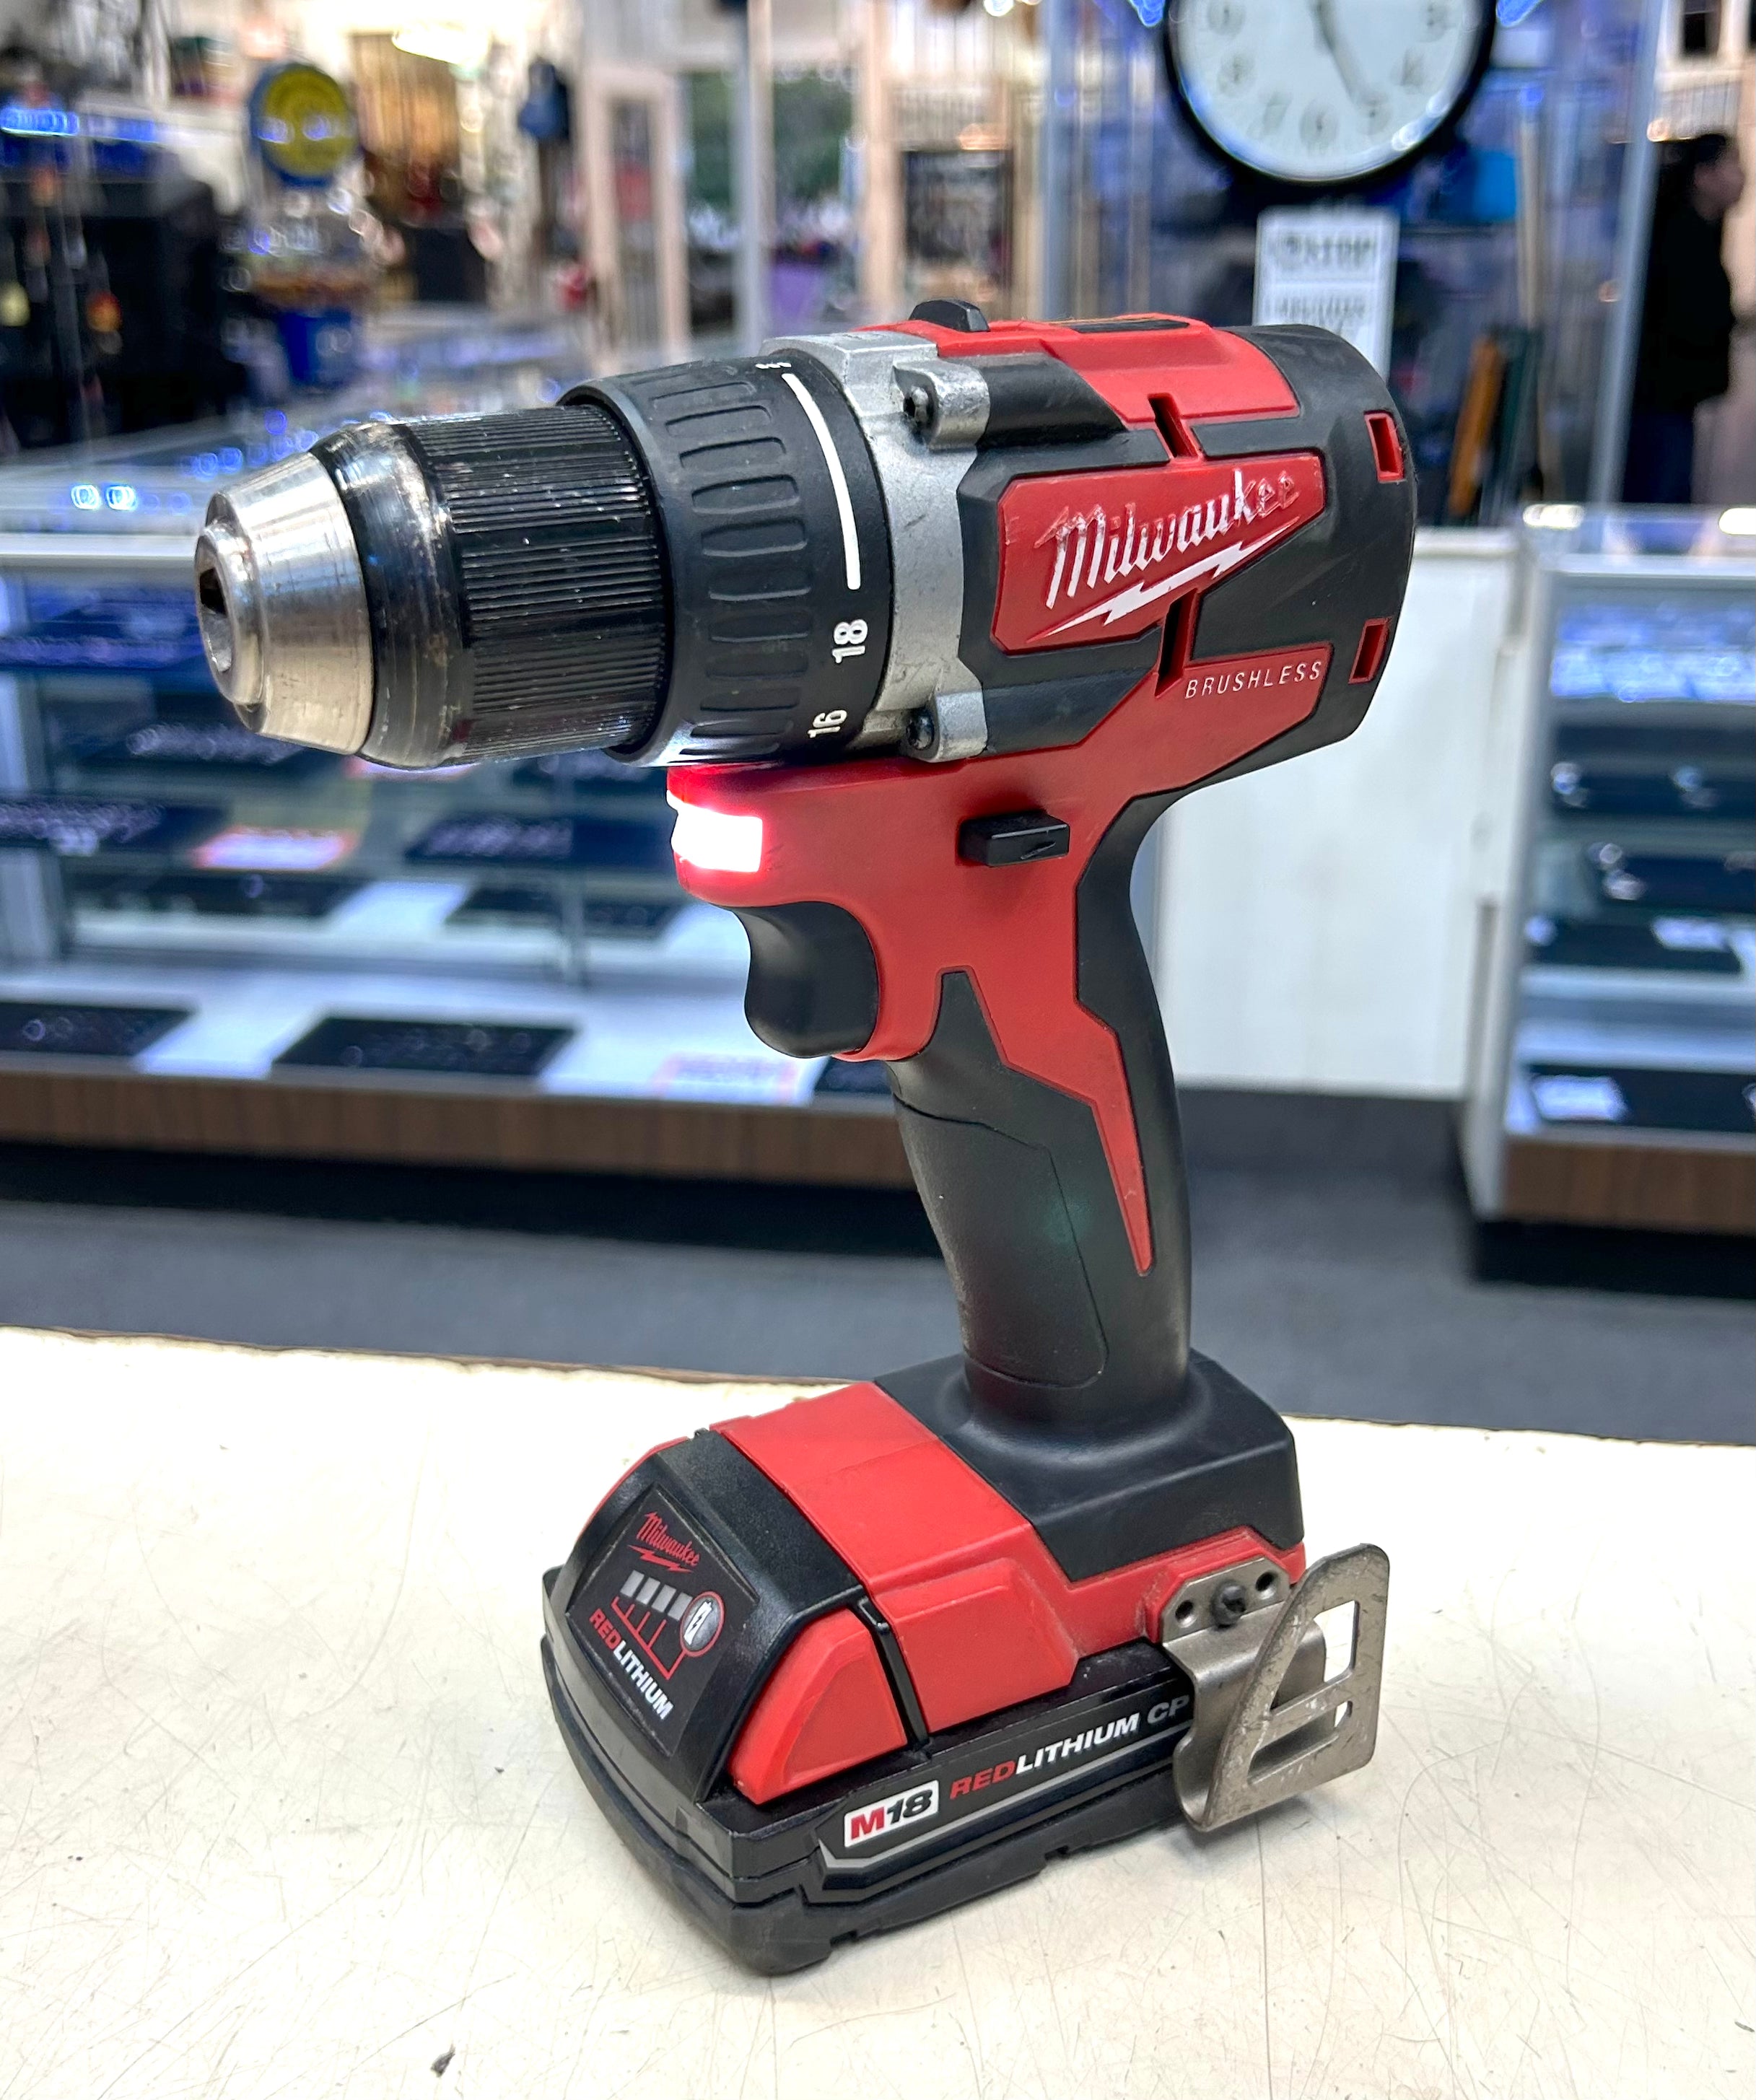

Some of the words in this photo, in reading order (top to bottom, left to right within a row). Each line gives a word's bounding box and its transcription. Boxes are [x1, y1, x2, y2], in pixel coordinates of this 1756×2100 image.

[1034, 468, 1299, 609] Milwaukee
[832, 618, 868, 665] 18
[1185, 662, 1322, 699] BRUSHLESS
[808, 709, 847, 739] 16
[637, 1511, 701, 1567] Milwaukee
[589, 1609, 673, 1720] REDLITHIUM
[850, 1789, 932, 1840] M18
[950, 1712, 1140, 1800] REDLITHIUM
[1148, 1695, 1189, 1724] CP
